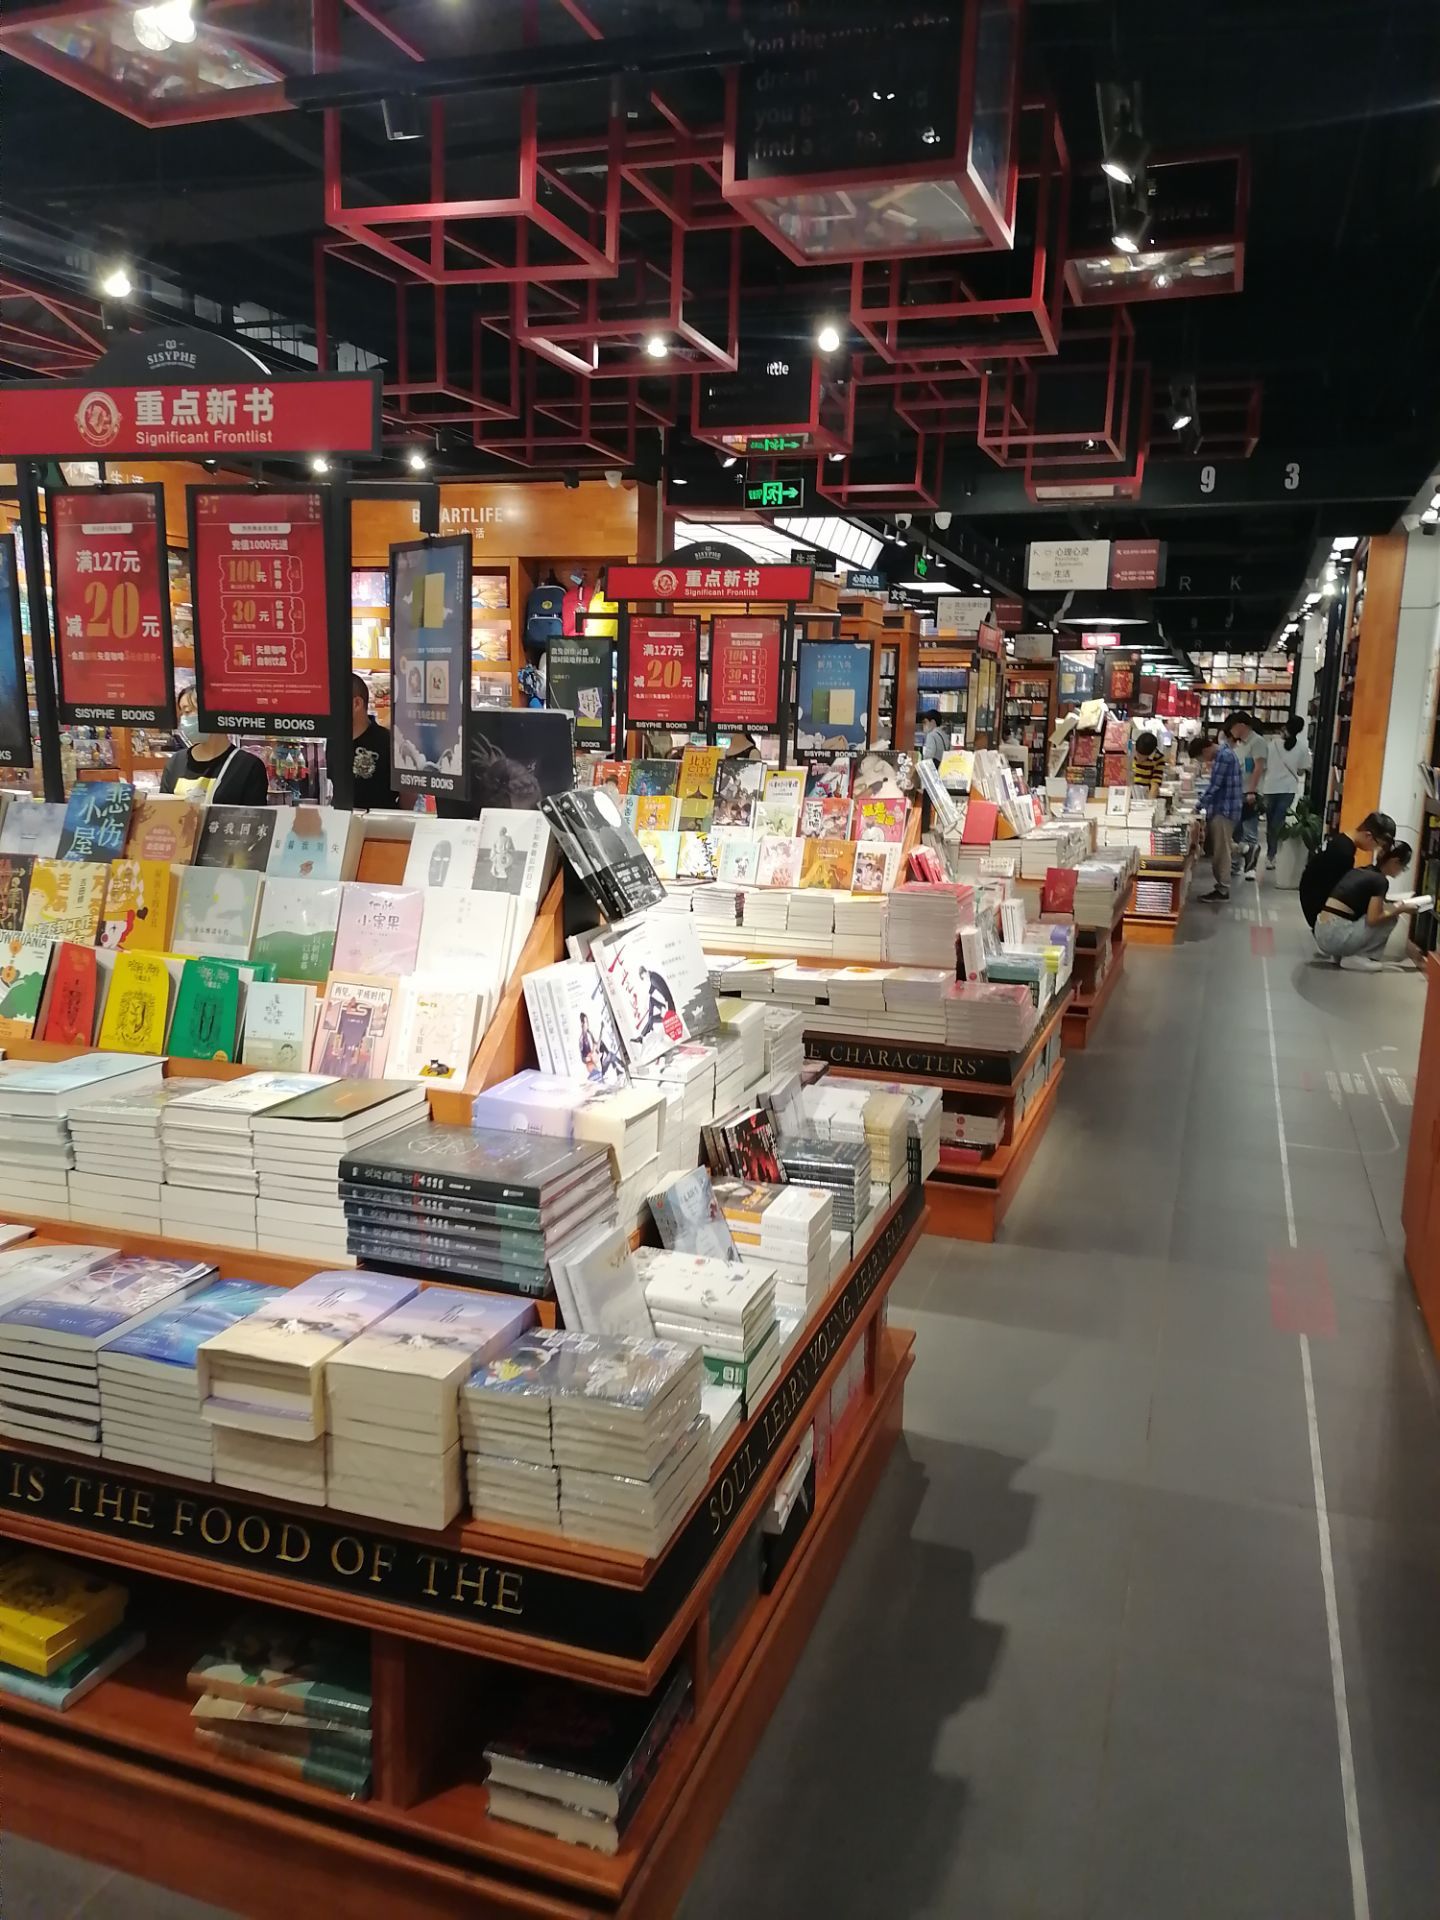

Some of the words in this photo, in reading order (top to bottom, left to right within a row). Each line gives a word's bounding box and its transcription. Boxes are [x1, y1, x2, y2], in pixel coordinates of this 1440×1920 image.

[147, 350, 197, 365] SISYPHE
[134, 387, 275, 426] 重点新书
[135, 430, 209, 445] Significant
[213, 430, 273, 444] Frontlist
[1200, 465, 1216, 493] 9
[1284, 463, 1300, 490] 3
[76, 550, 141, 573] 满127元
[684, 569, 760, 588] 重点新书
[1054, 570, 1070, 578] 生活
[684, 588, 724, 598] Significant
[726, 587, 759, 597] Frontlist
[643, 644, 684, 656] 满127元
[75, 708, 115, 720] SISYPHE
[122, 709, 155, 721] BOOKS
[218, 716, 266, 729] SISYPHE
[274, 718, 315, 731] BOOKS
[717, 723, 743, 731] SISYPHE
[400, 774, 427, 788] SISYPHE
[430, 777, 453, 790] BOOKS
[98, 783, 132, 847] 悲伤
[63, 796, 102, 858] 小屋
[207, 820, 269, 846] 带我回家
[762, 1369, 808, 1451] LEARN
[8, 1461, 46, 1502] IS
[65, 1476, 156, 1529] THE
[171, 1501, 311, 1563] FOOD
[331, 1536, 398, 1582] OF
[416, 1554, 524, 1615] THE
